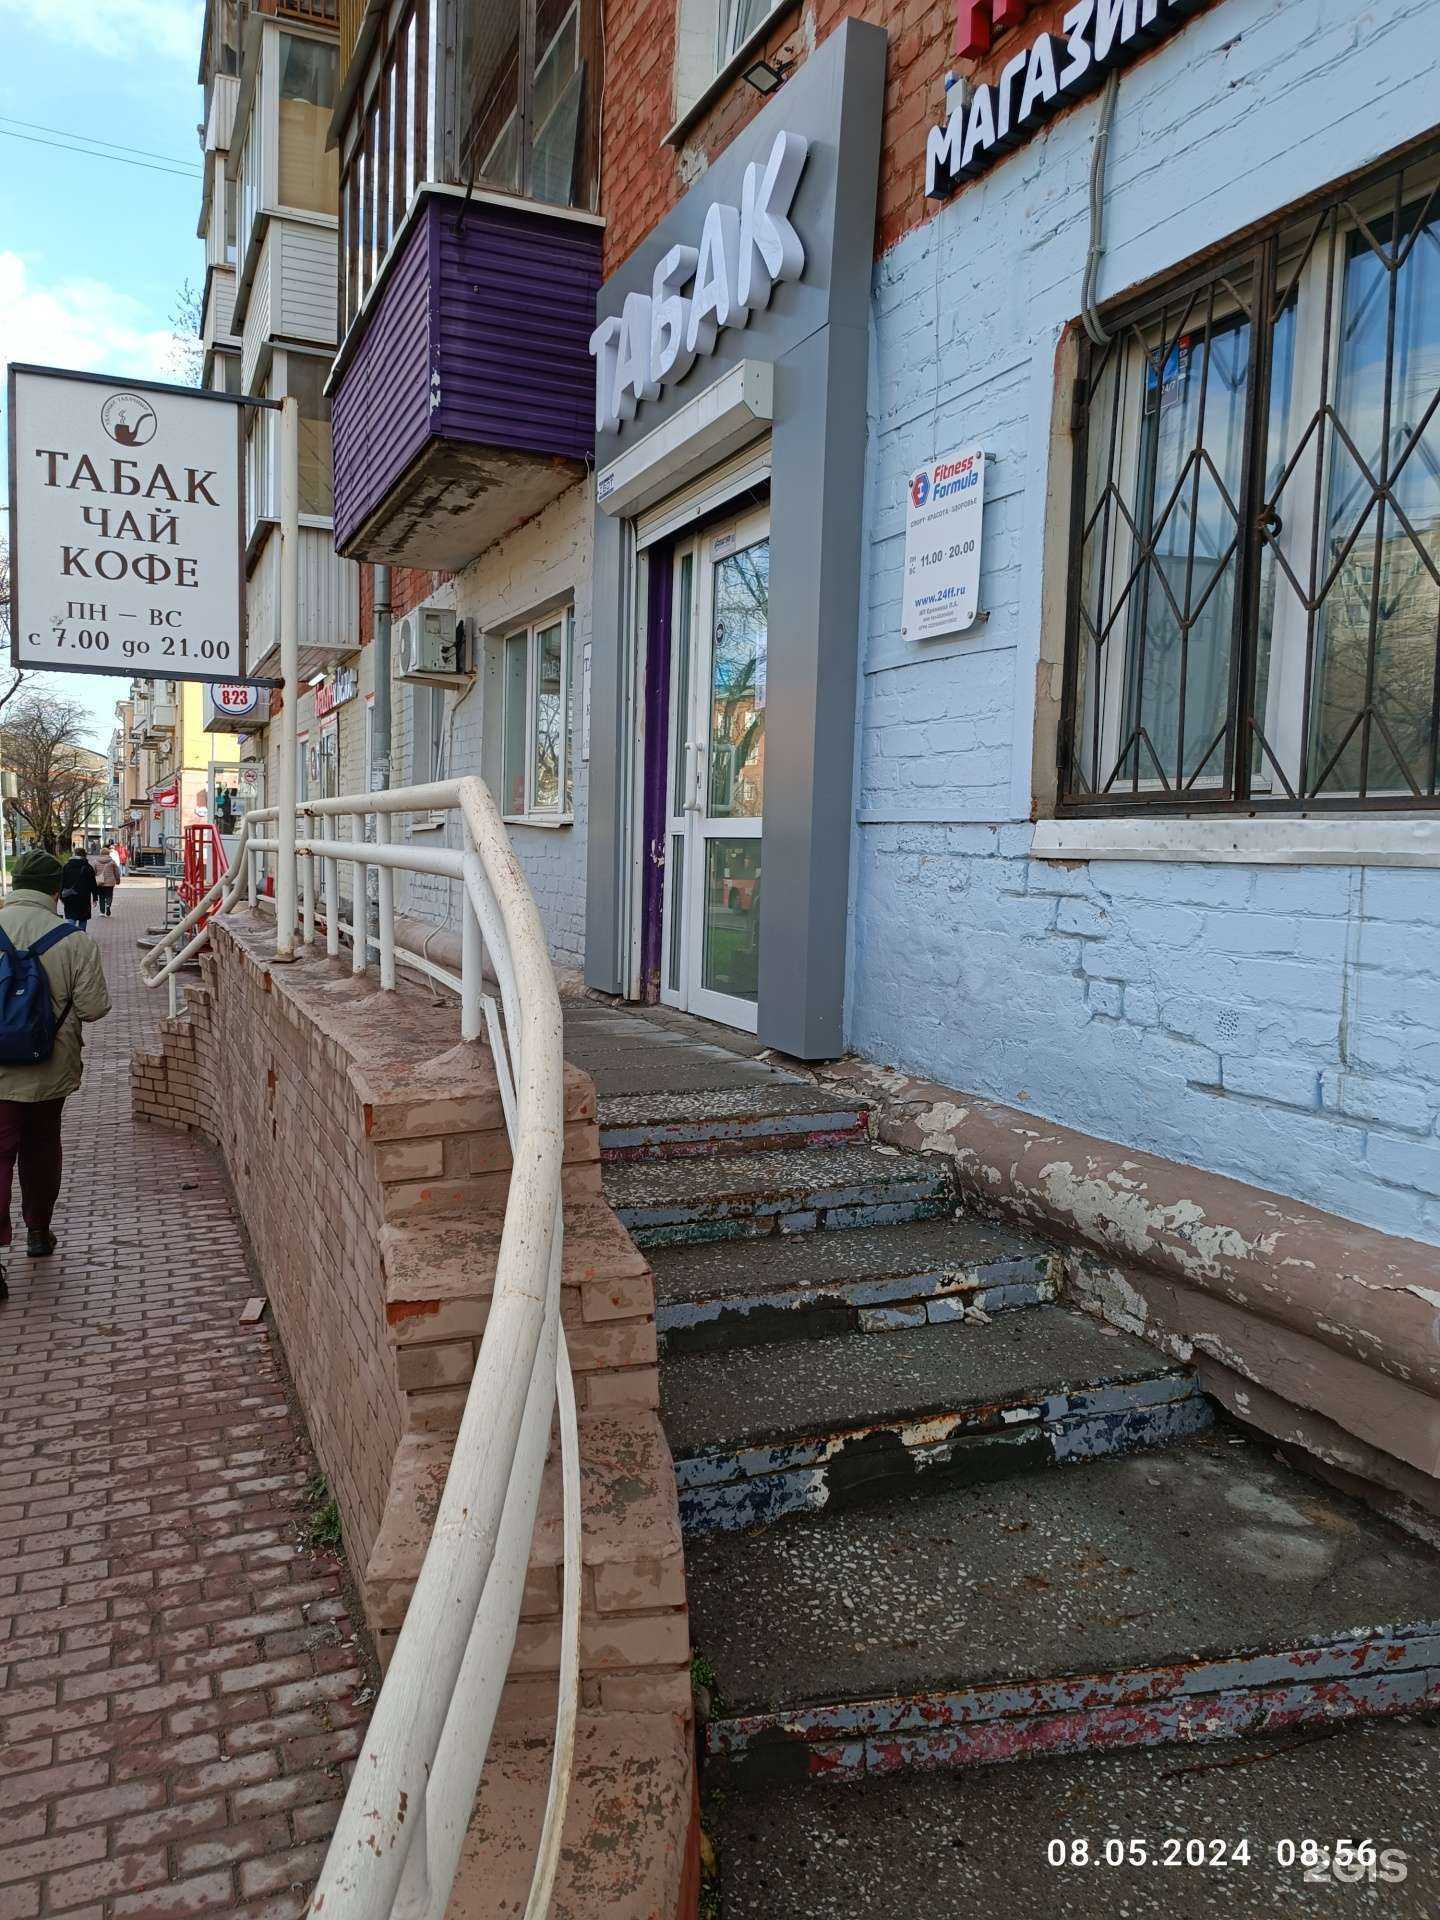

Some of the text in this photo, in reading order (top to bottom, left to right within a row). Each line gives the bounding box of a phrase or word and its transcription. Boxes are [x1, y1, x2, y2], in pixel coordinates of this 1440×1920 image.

[925, 0, 1181, 197] МАГАЗИ
[589, 130, 800, 433] ТАБАК
[35, 448, 220, 507] ТАБАК
[933, 456, 974, 484] Fitness
[933, 469, 979, 501] Formula
[80, 506, 180, 545] ЧАЙ
[60, 545, 199, 588] КОФЕ
[920, 539, 975, 567] 11.00 20.00
[914, 586, 966, 607] www.24ff.ru
[67, 601, 108, 621] ПН
[148, 608, 182, 628] ВС
[52, 627, 110, 651] 7.00
[161, 636, 230, 660] 21.00
